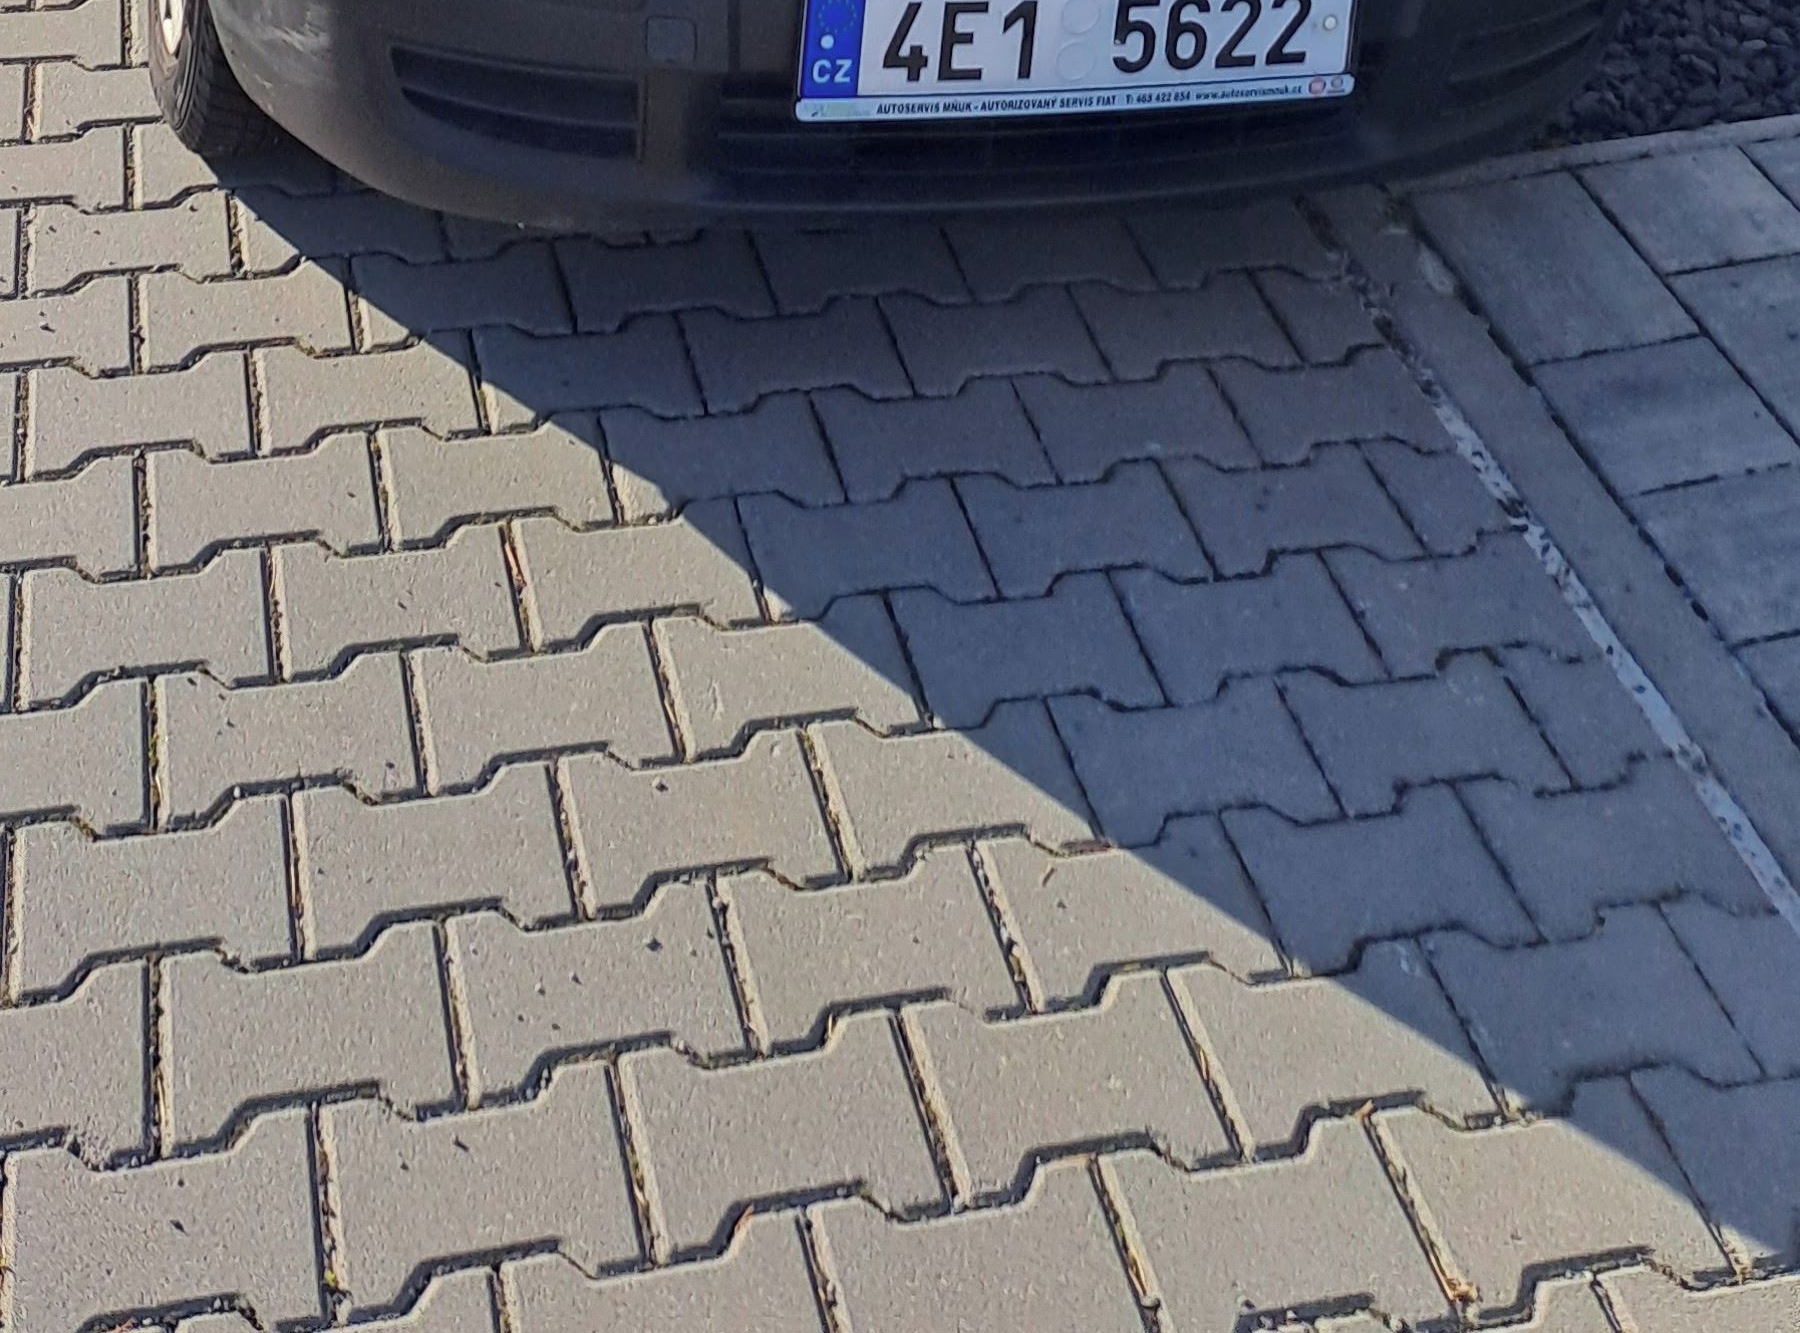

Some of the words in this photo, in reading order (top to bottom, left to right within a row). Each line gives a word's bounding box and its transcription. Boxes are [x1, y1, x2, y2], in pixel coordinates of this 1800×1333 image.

[882, 0, 1039, 82] 4E1
[812, 58, 853, 84] CZ
[876, 101, 941, 115] AUTOSERVIS
[1060, 95, 1095, 109] SERVIS
[1096, 94, 1117, 107] FIAT
